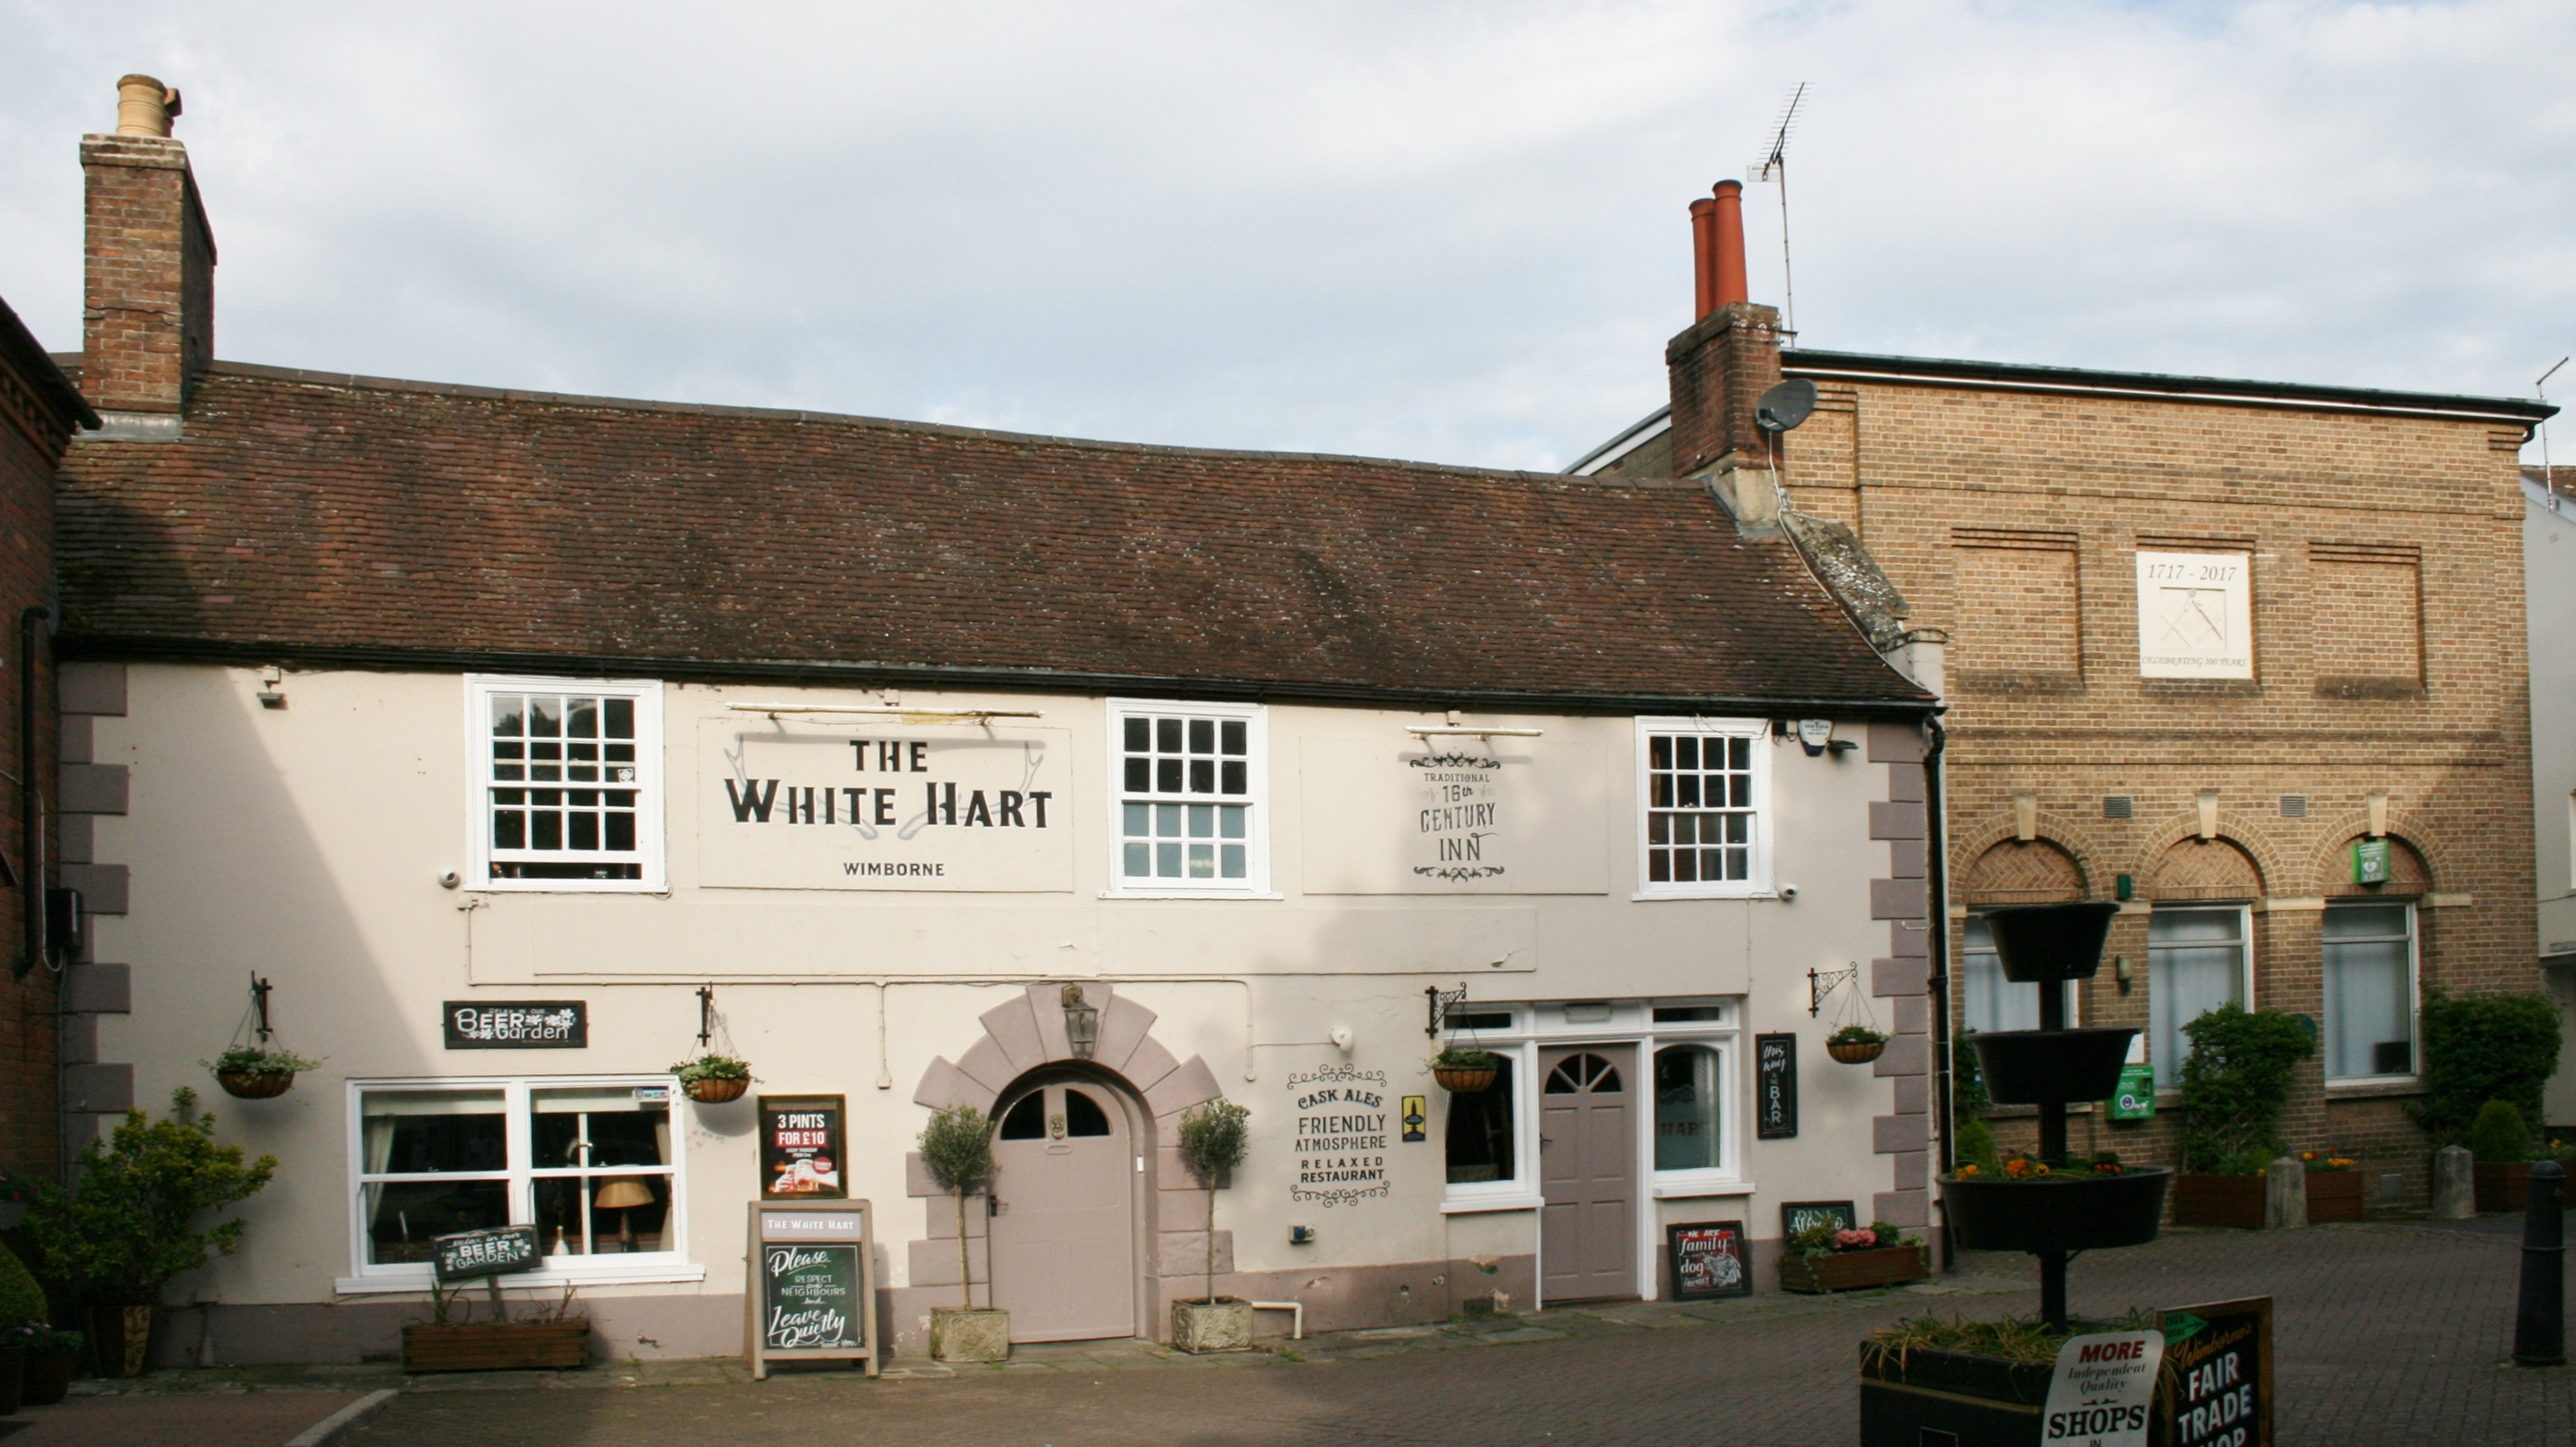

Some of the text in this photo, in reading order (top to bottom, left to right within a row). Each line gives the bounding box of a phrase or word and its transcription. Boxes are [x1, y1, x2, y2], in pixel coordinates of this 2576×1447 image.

[2148, 564, 2184, 580] 1717
[2199, 565, 2237, 581] 2017
[2142, 656, 2246, 667] CELEBRATING 300 YEARS
[850, 739, 927, 772] THE
[1424, 773, 1490, 783] TRADITIONAL
[1443, 784, 1474, 802] 16th
[725, 778, 1052, 829] WHITE HART
[1420, 802, 1496, 833] CENTURY
[1439, 833, 1490, 860] INN
[843, 862, 944, 877] WIMBORNE
[455, 1008, 525, 1032] BEER
[496, 1023, 568, 1039] Garden
[1298, 1090, 1382, 1108] CASK ALES
[1770, 1086, 1781, 1123] BAR
[777, 1114, 824, 1128] 3 PINTS
[1299, 1114, 1386, 1135] FRIENDLY
[778, 1131, 825, 1146] FOR £10
[1295, 1136, 1386, 1152] ATMOSPHERE
[1301, 1156, 1382, 1169] RELAXED
[1301, 1169, 1384, 1183] RESTAURANT
[767, 1220, 854, 1229] THE WHITE HART
[501, 1232, 522, 1240] our
[460, 1240, 510, 1257] BEER
[1679, 1237, 1727, 1256] family
[456, 1251, 519, 1269] GARDEN
[769, 1247, 829, 1277] Please
[1680, 1258, 1704, 1275] dog
[795, 1275, 832, 1283] RESPECT
[781, 1287, 845, 1296] NEIGHBOURS
[767, 1305, 821, 1337] Leave
[781, 1308, 845, 1348] Quietly
[2078, 1340, 2145, 1364] MORE
[2174, 1322, 2252, 1368] Wimborne's
[2068, 1363, 2145, 1380] Independent
[2189, 1351, 2241, 1403] FAIR
[2080, 1378, 2125, 1395] Quality
[2048, 1405, 2145, 1439] SHOPS
[2178, 1383, 2253, 1443] TRADE
